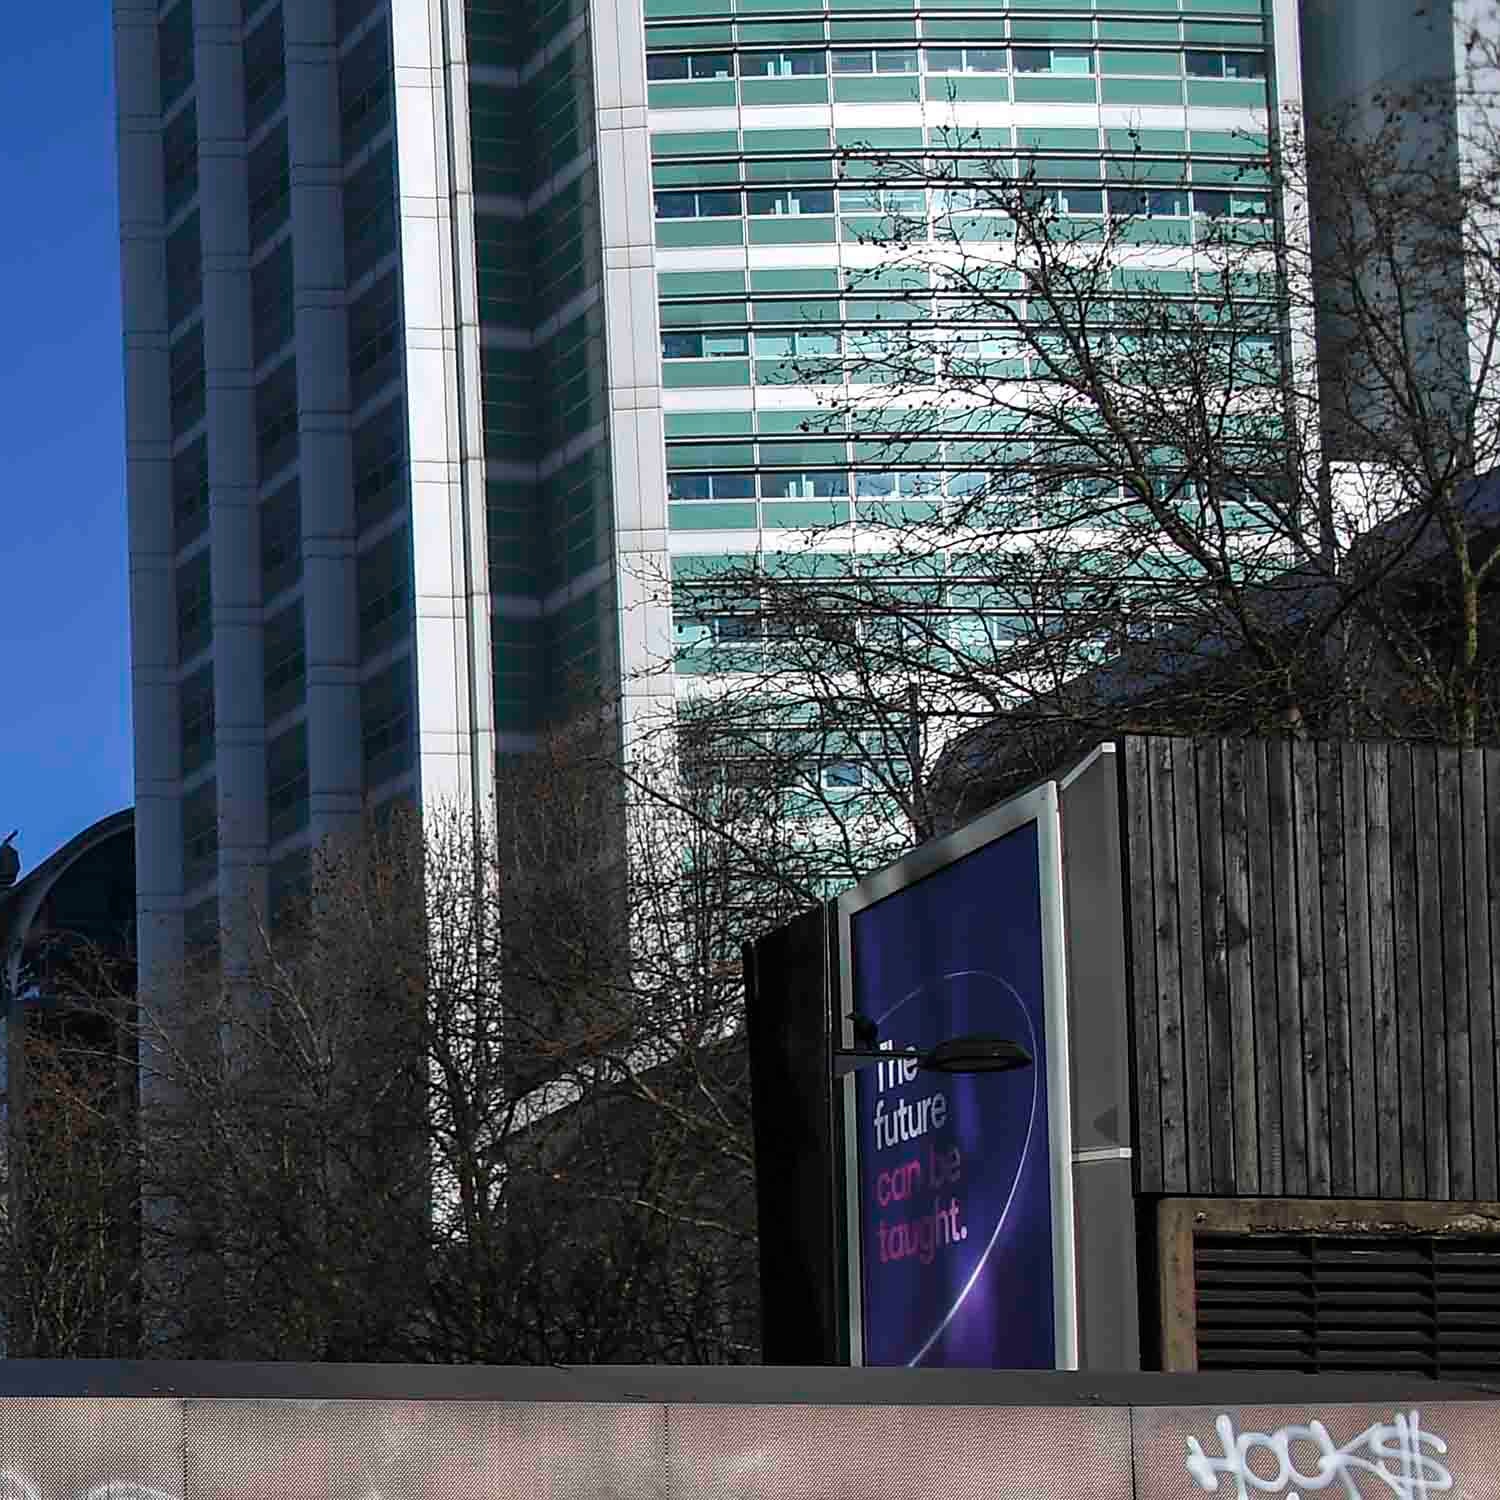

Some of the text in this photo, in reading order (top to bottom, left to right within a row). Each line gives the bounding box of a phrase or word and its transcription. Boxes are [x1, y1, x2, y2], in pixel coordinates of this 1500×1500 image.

[876, 1039, 919, 1093] The
[873, 1092, 948, 1150] future
[878, 1196, 968, 1265] taught.
